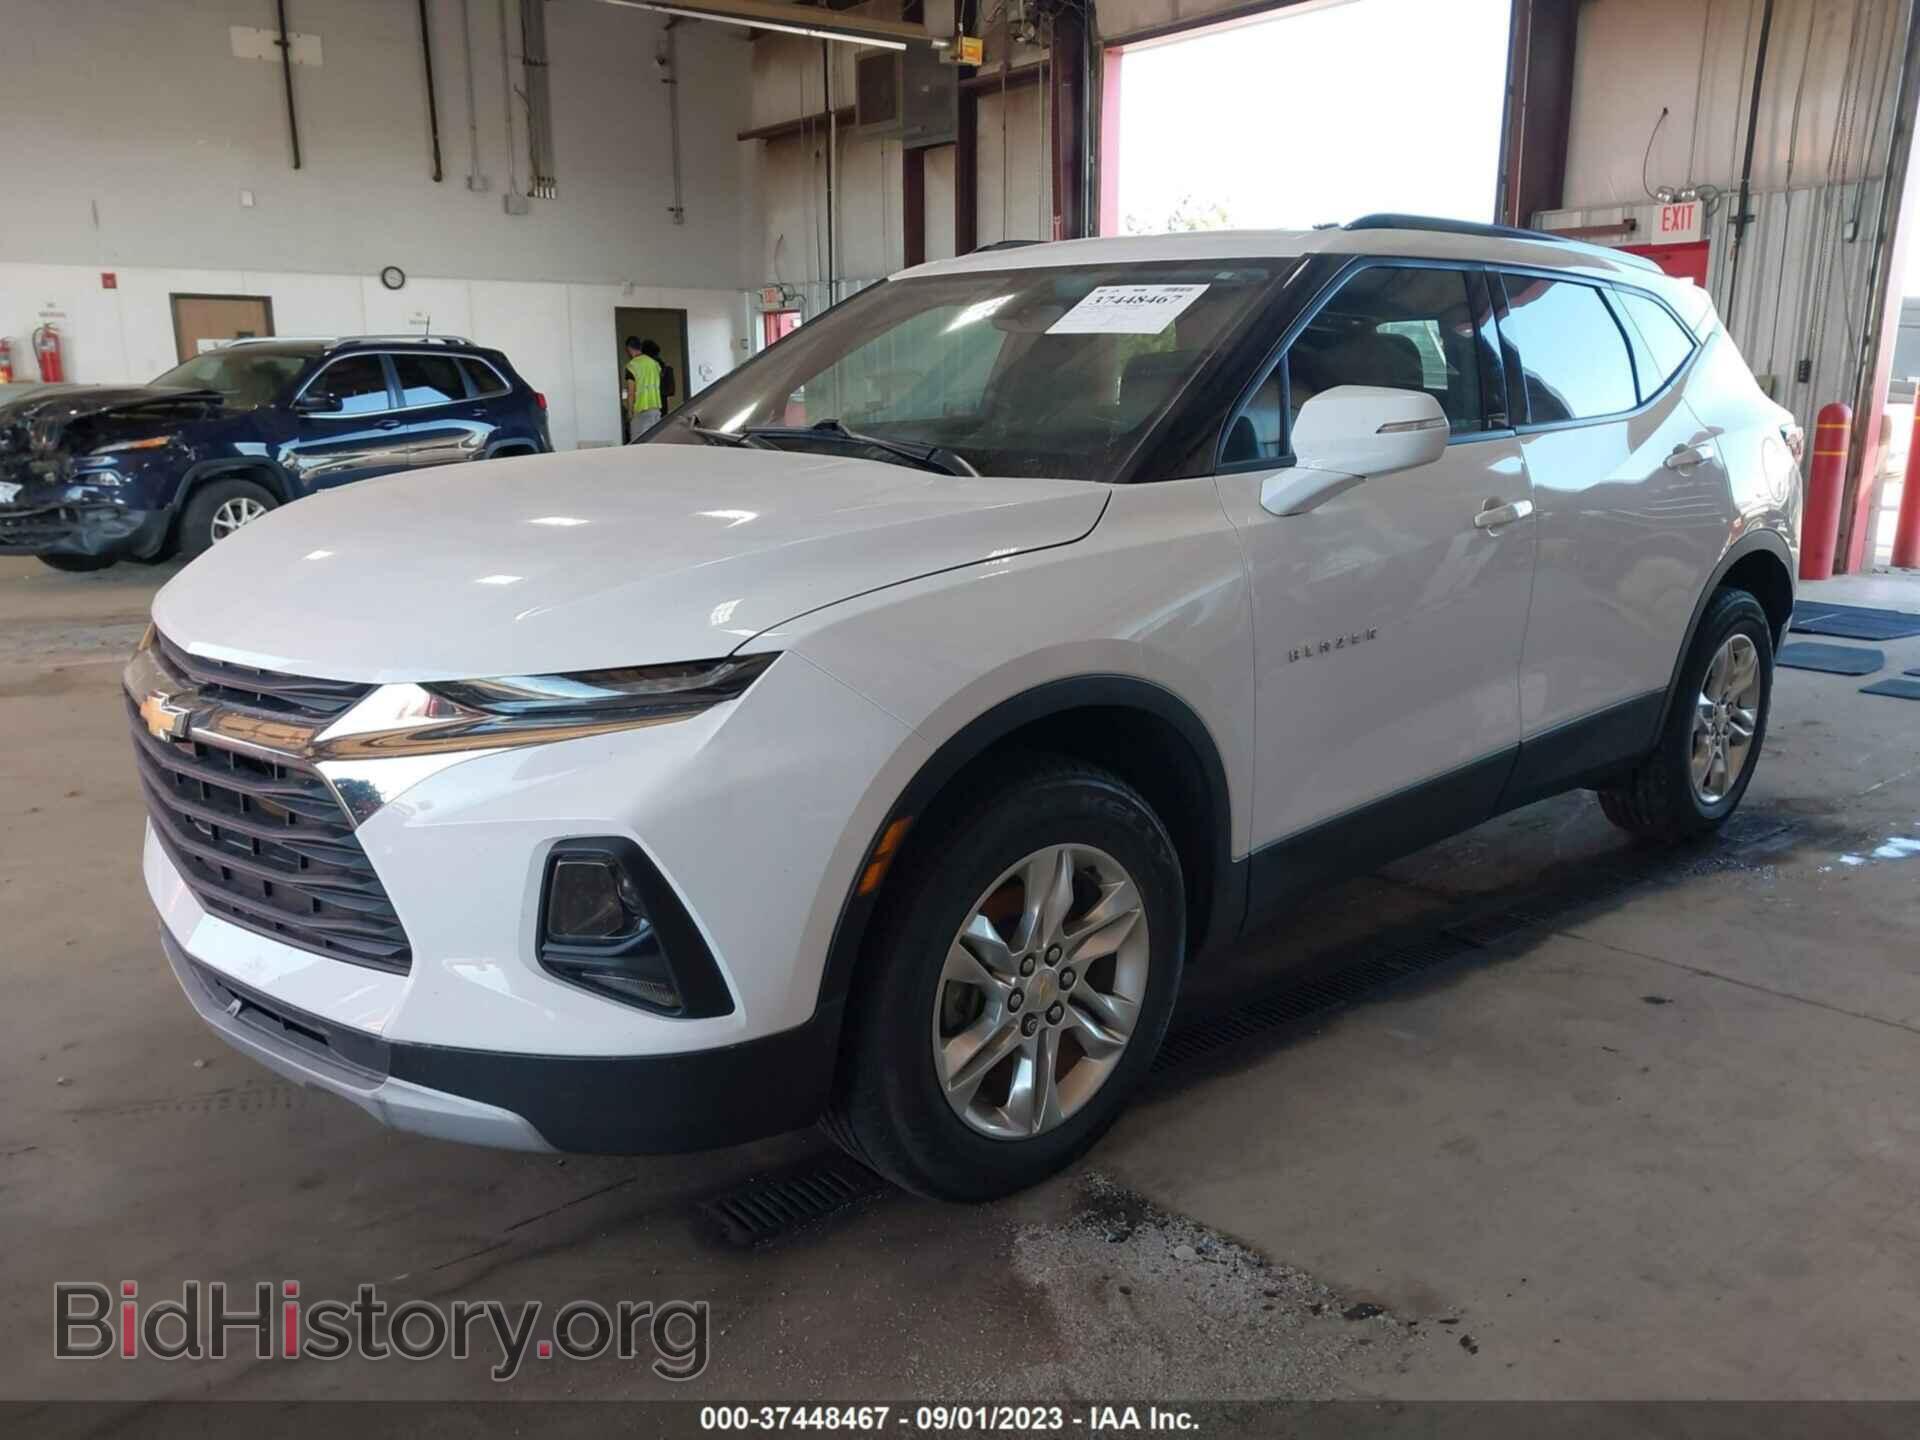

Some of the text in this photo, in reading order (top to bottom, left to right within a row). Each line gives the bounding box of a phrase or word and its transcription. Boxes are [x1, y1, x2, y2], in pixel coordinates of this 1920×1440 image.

[1662, 205, 1695, 231] EXIT
[1088, 294, 1184, 306] 37448467
[1287, 627, 1378, 663] BLAZER
